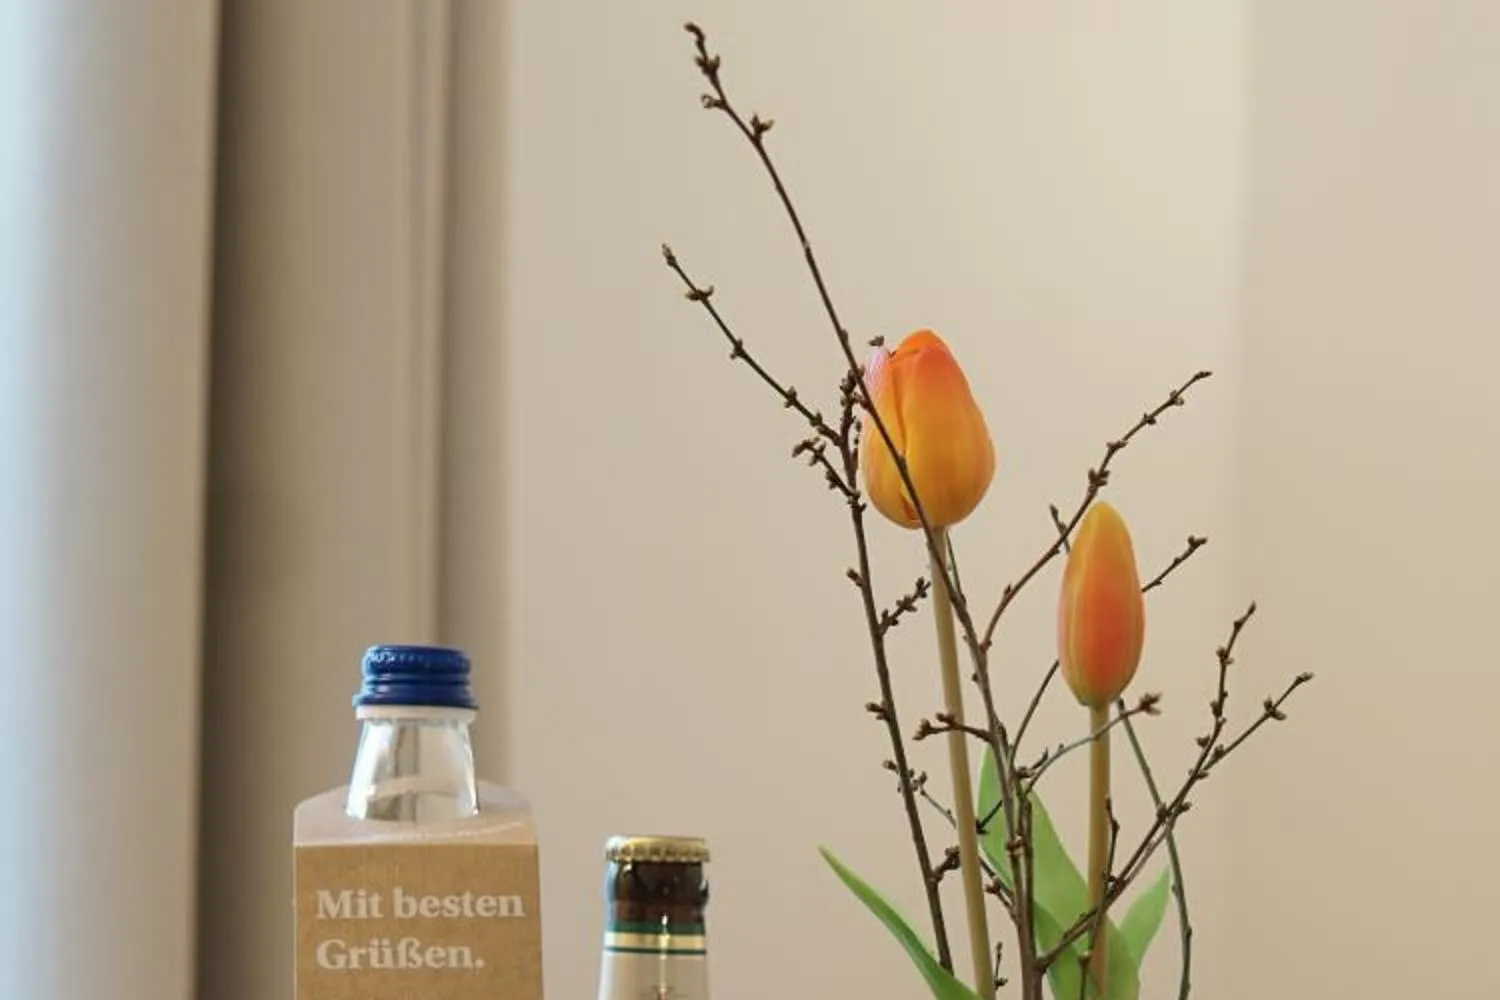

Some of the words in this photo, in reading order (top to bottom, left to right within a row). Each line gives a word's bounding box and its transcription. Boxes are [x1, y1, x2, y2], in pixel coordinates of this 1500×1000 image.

[316, 889, 384, 919] Mit
[393, 887, 526, 918] besten
[316, 937, 485, 969] Grüßen.
